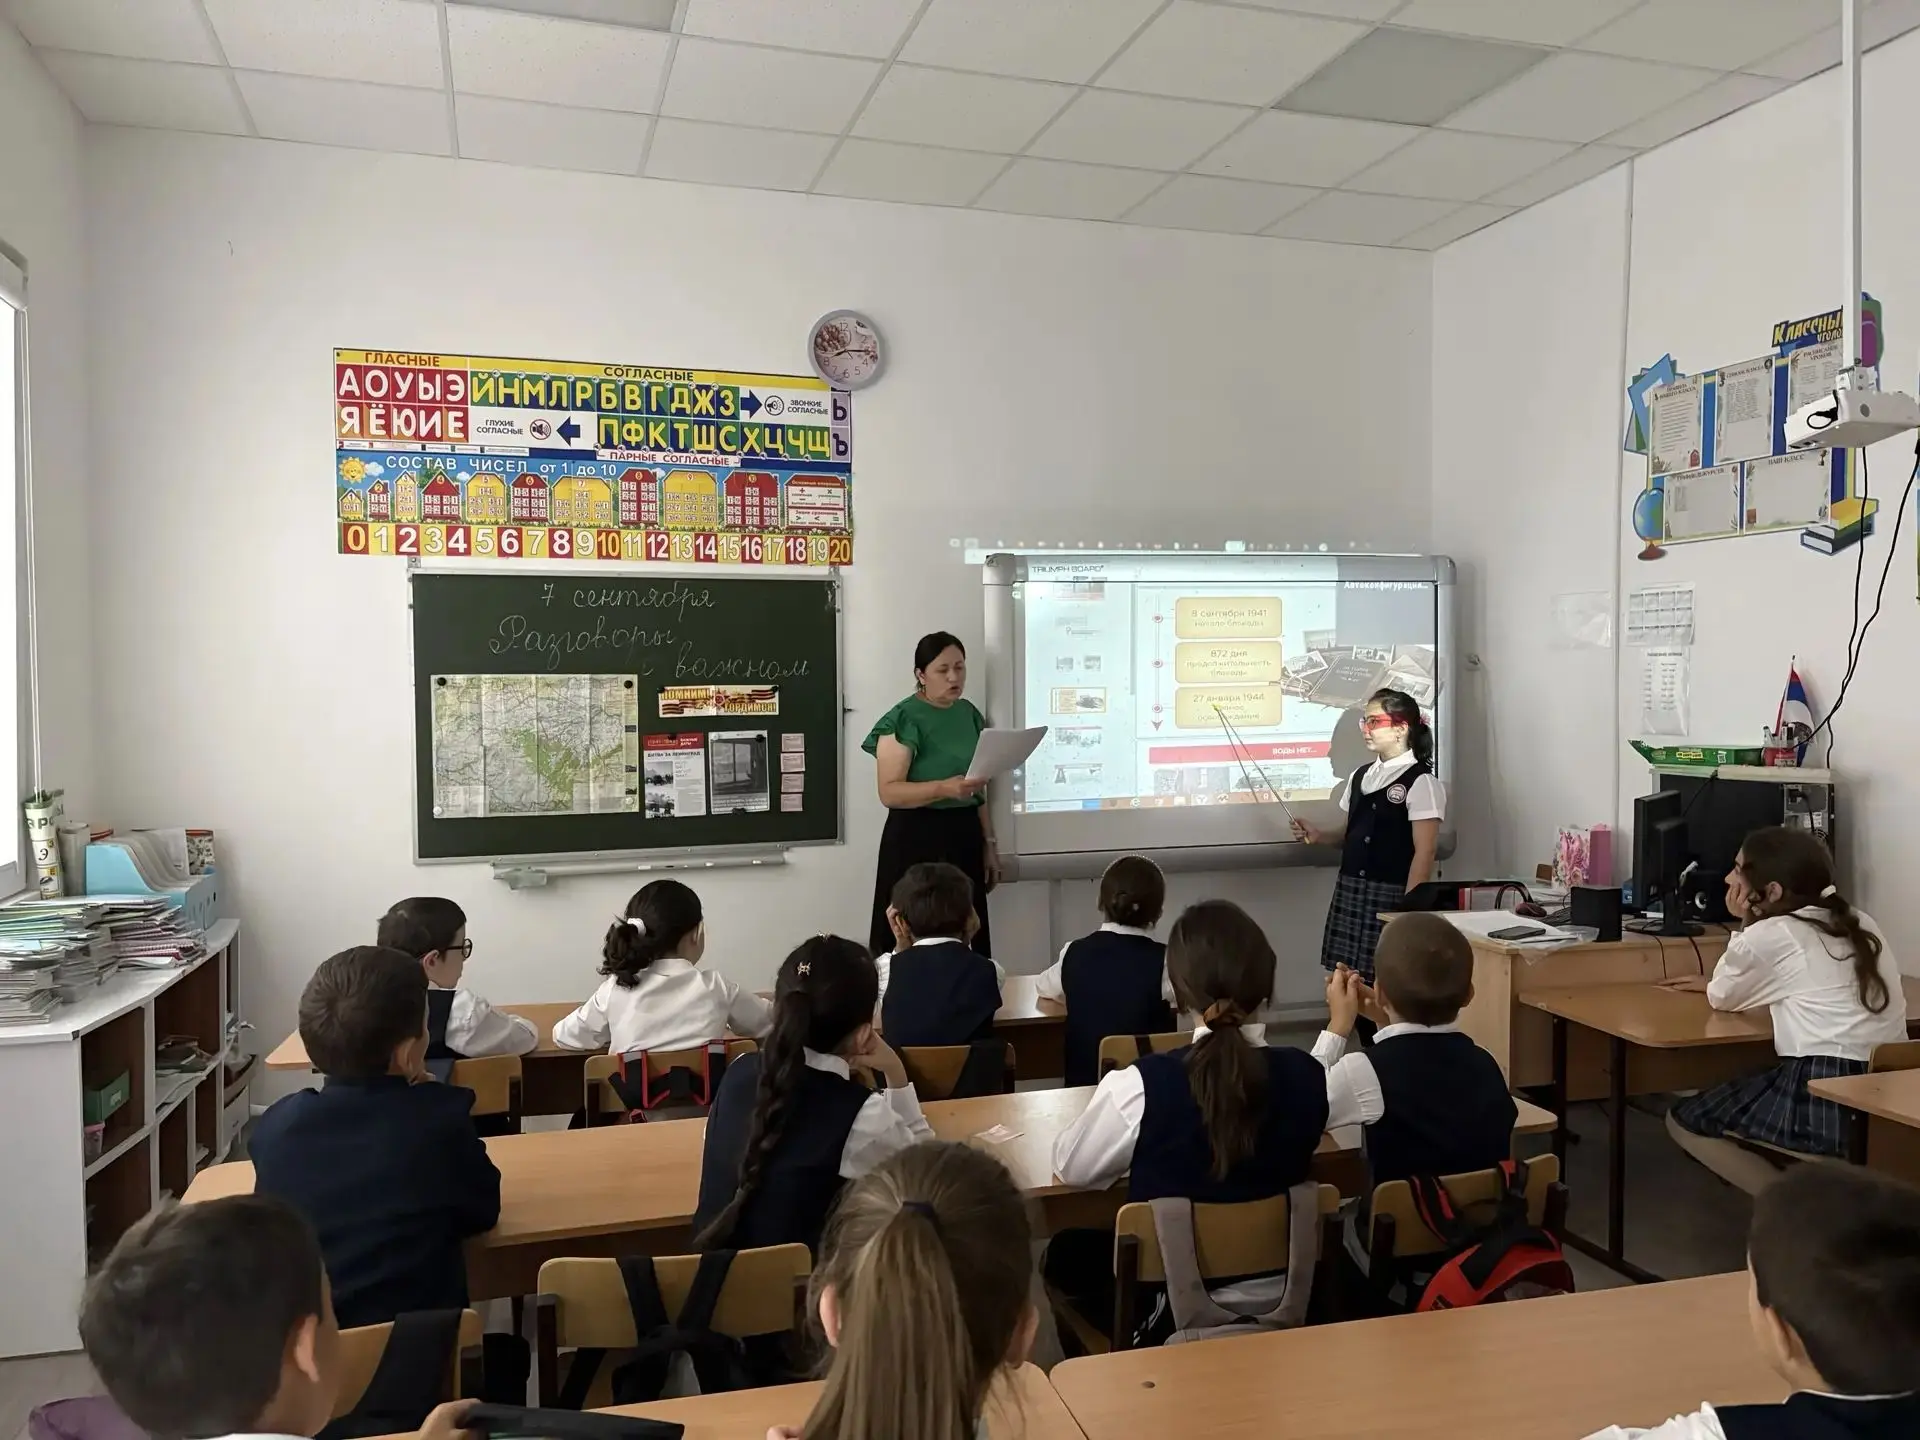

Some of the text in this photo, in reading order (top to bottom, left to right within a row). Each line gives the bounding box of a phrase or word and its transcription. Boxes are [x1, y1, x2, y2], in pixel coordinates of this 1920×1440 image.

[840, 322, 848, 332] 12
[1817, 328, 1843, 342] уголо
[365, 352, 440, 367] ГЛАСНЫЕ
[823, 357, 830, 366] 8
[862, 358, 868, 368] 4
[604, 367, 694, 381] СОГЛАСНЫЕ
[832, 366, 838, 374] 7
[844, 368, 850, 378] 6
[854, 366, 860, 375] 5
[790, 400, 822, 408] ЗВОНКИЕ
[788, 406, 828, 414] СОГЛАСНЫЕ
[833, 398, 848, 421] Ь
[485, 420, 514, 428] ГЛУХИЕ
[476, 426, 524, 435] СОГЛАСНЫЕ
[832, 433, 848, 456] Ъ
[610, 452, 730, 466] ПАРНЫЕ СОГЛАСНЫЕ
[386, 456, 616, 476] СОСТАВ ЧИСЕЛ от 1 до 10
[347, 526, 850, 562] 0 1 2 3 4 5 6 7 8 9 10 11 12 13 14 15 16 17 18 19 20
[541, 581, 715, 622] 7 сентября
[1191, 610, 1198, 618] 8
[1248, 610, 1268, 618] 1941
[488, 615, 677, 670] Разговоры
[1210, 650, 1228, 658] 872
[676, 640, 810, 680] важном
[1193, 694, 1204, 702] 27
[1243, 693, 1264, 701] 1944
